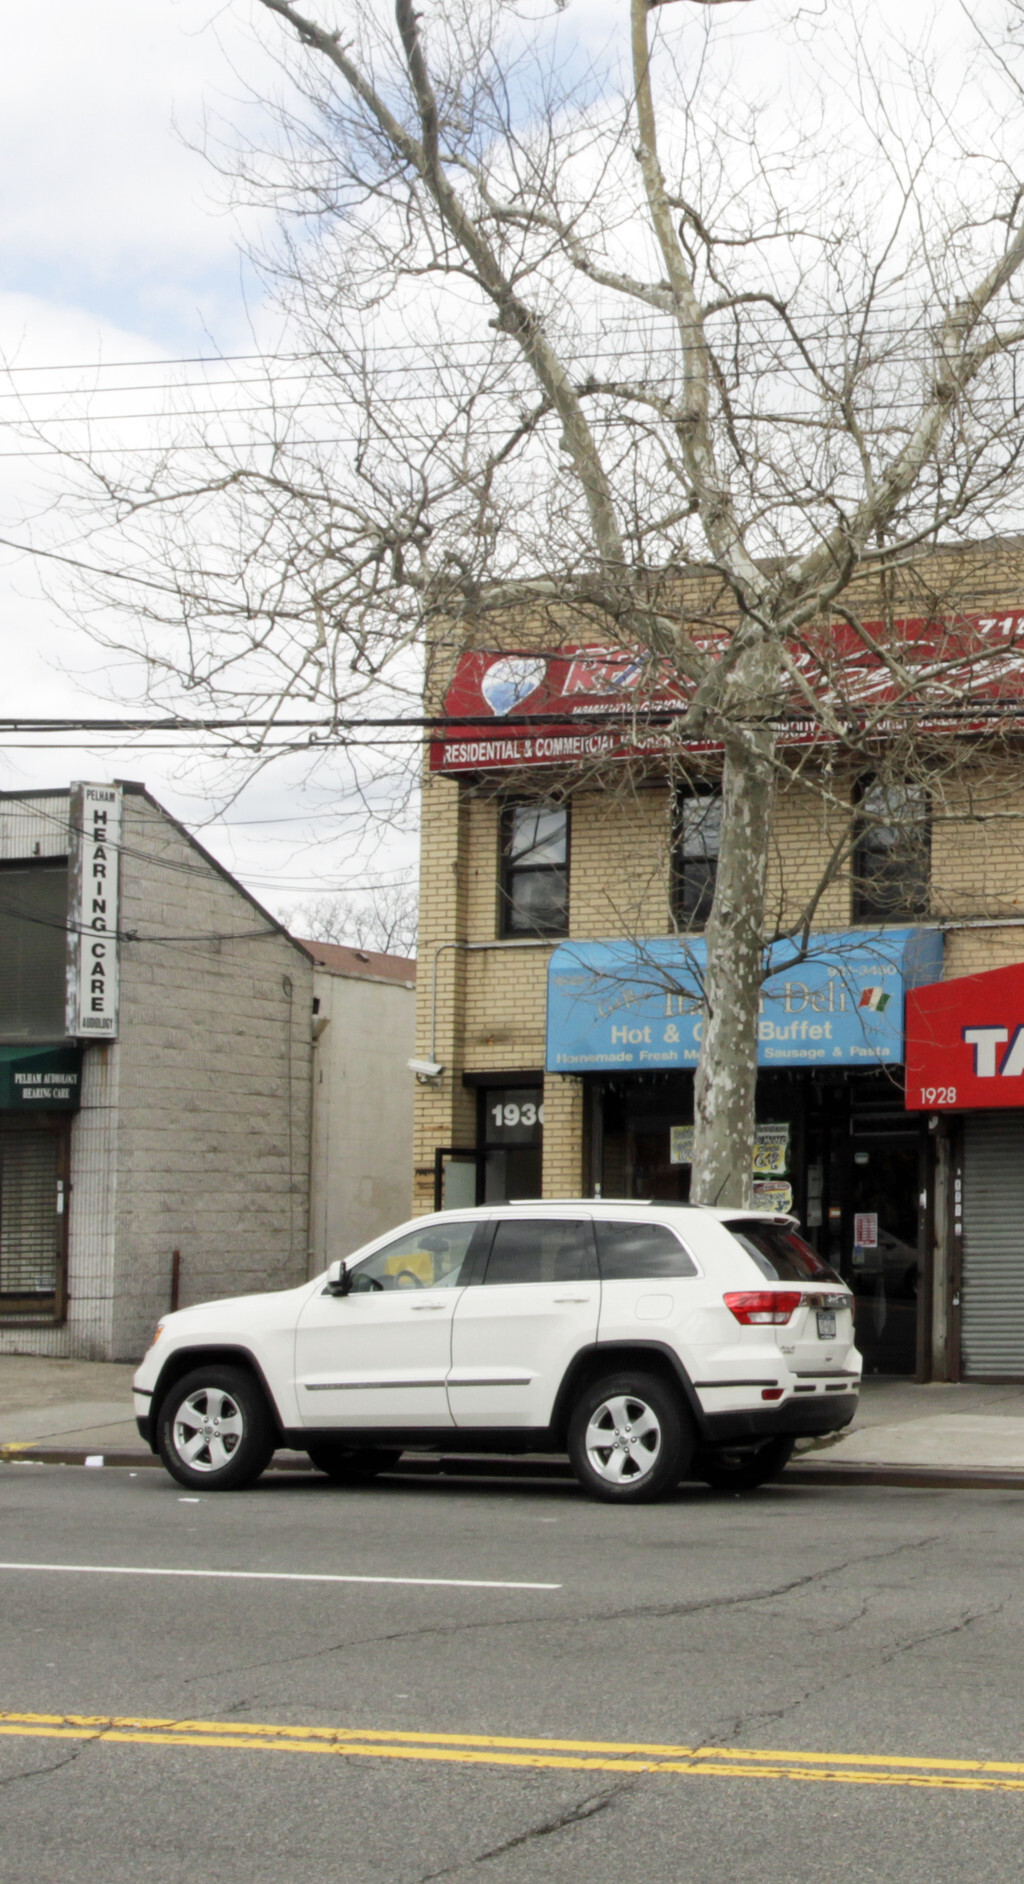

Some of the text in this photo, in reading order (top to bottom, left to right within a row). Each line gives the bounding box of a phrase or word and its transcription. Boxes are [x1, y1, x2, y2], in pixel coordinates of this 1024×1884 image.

[443, 742, 521, 763] RESIDENTIAL
[524, 739, 533, 757] &
[535, 735, 614, 756] COMMERCIAL
[86, 789, 115, 802] PELHAM
[91, 810, 107, 1012] HEARING CARE
[784, 980, 848, 1014] Deli
[611, 1025, 652, 1044] Hot
[663, 1024, 680, 1043] &
[759, 1020, 832, 1040] Buffet
[556, 1052, 633, 1063] Homemade
[639, 1050, 678, 1061] Fresh
[764, 1047, 825, 1060] Sausage
[832, 1046, 842, 1057] &
[851, 1045, 890, 1057] Pasta
[53, 1088, 70, 1099] CARE
[920, 1087, 957, 1105] 1928
